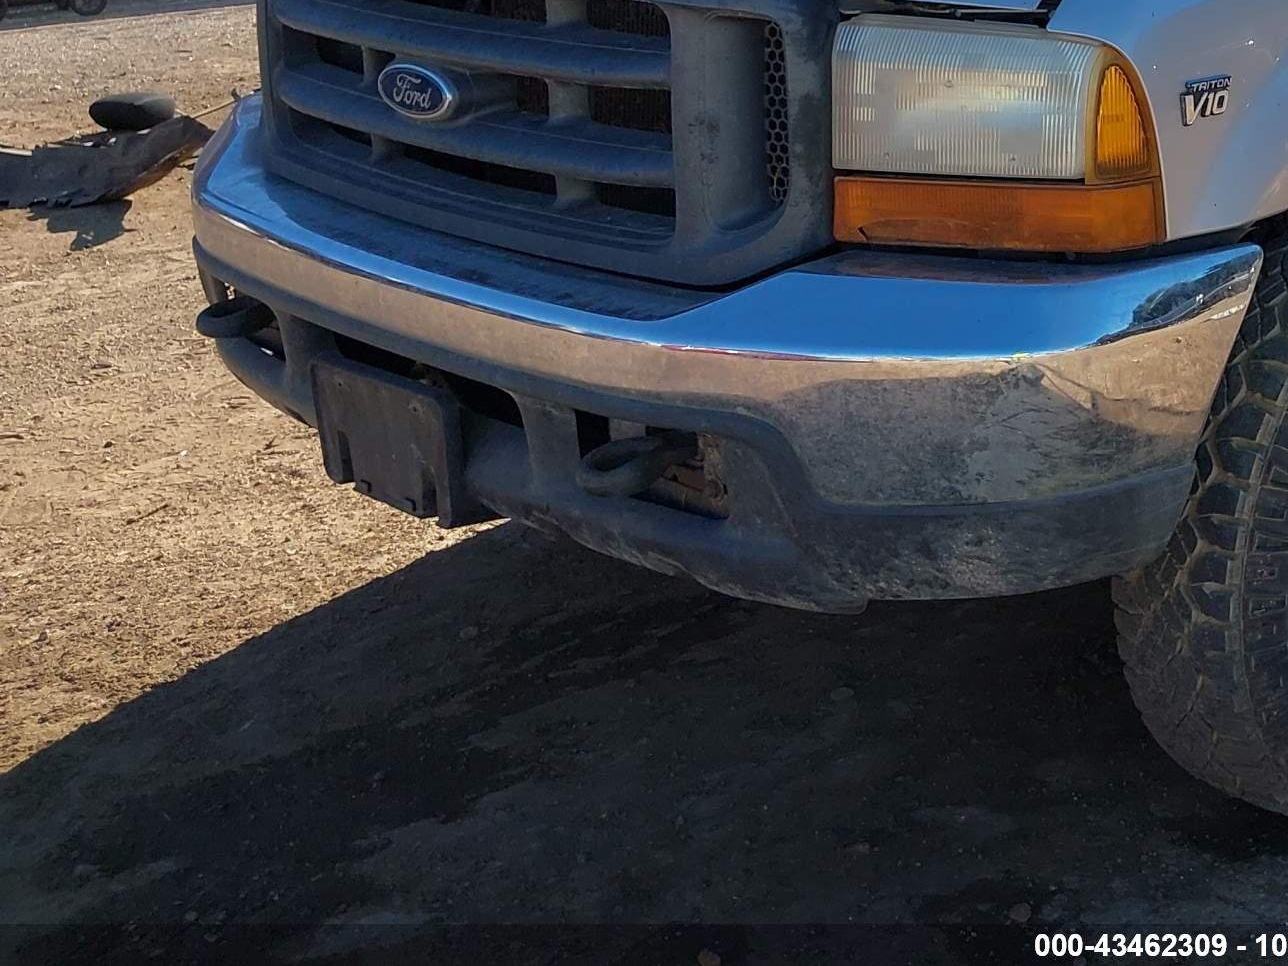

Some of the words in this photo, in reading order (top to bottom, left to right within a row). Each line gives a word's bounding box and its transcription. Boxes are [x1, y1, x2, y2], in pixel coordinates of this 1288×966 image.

[393, 74, 432, 109] Ford
[1191, 77, 1232, 92] TRITON
[1183, 89, 1229, 125] V10
